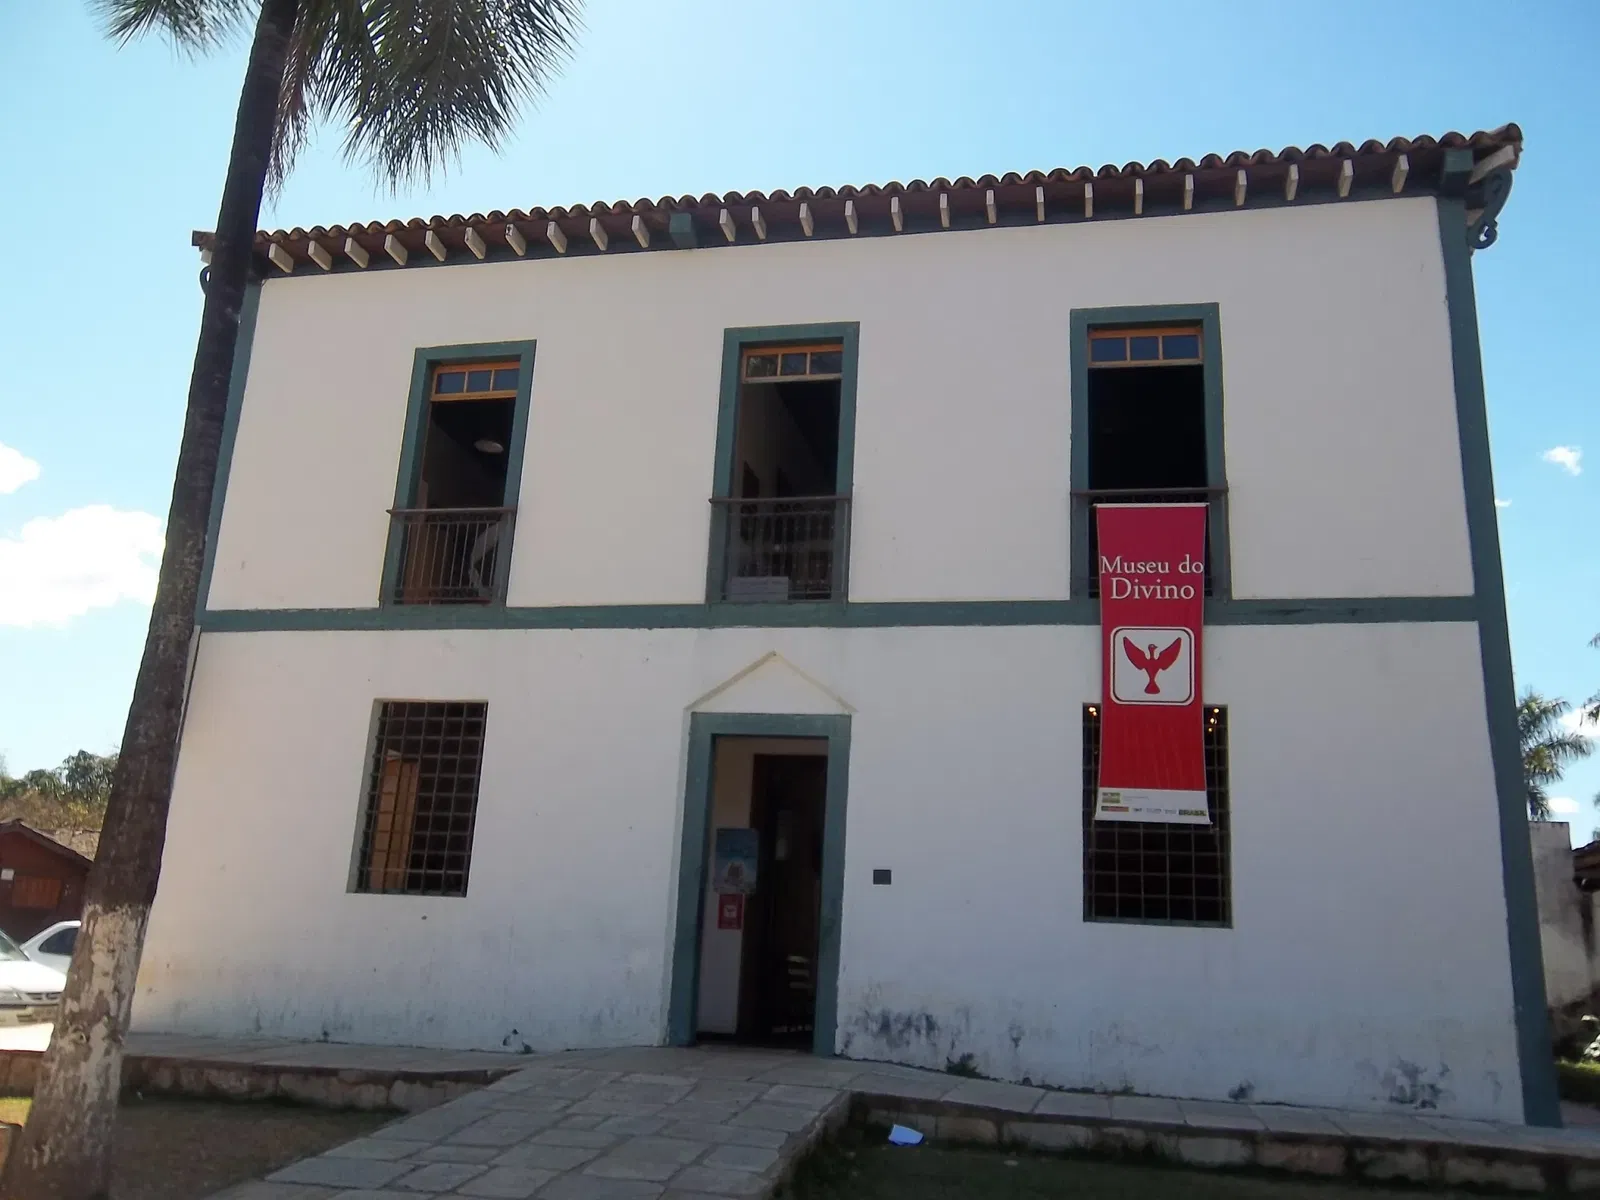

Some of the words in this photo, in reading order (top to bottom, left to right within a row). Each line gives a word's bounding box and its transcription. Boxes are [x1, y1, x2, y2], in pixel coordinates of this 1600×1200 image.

[1101, 556, 1169, 573] Museu
[1178, 554, 1204, 573] do
[1110, 577, 1195, 599] Divino
